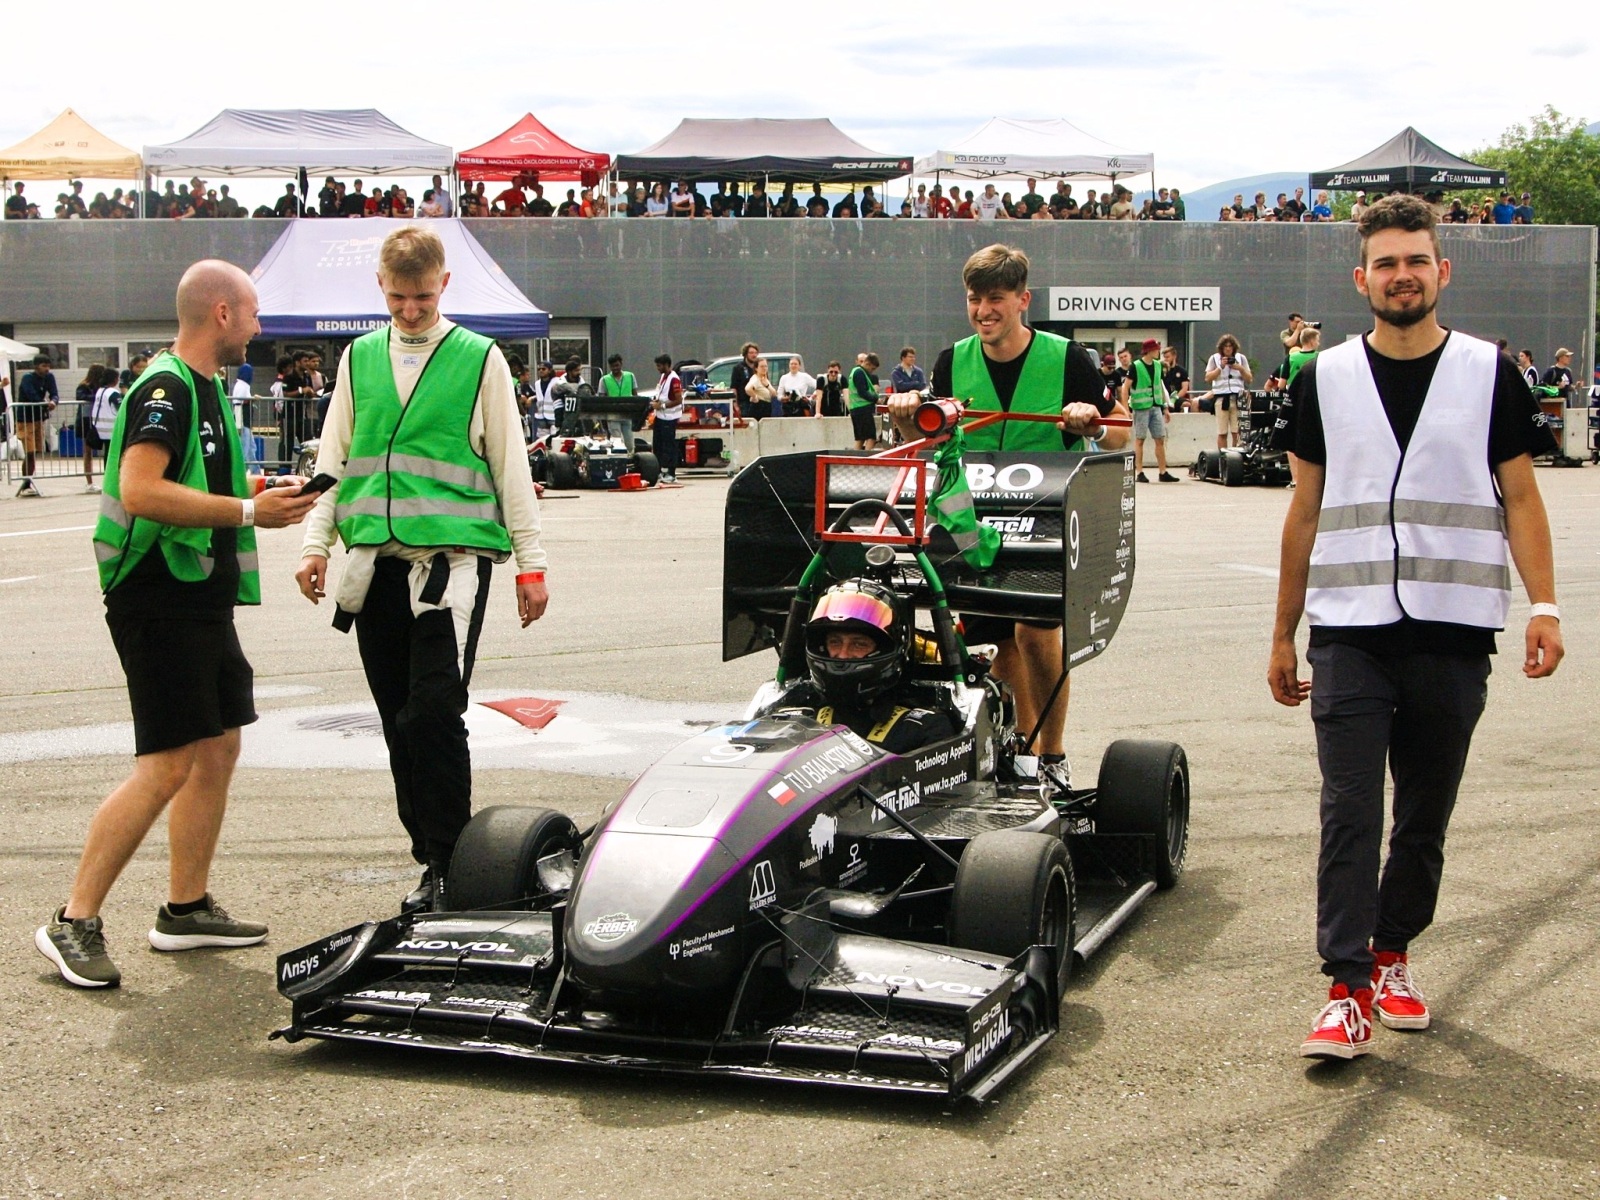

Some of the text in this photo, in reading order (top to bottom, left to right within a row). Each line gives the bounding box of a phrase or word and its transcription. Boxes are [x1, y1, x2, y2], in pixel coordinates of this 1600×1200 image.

[869, 161, 899, 169] STAR
[1343, 174, 1390, 185] TEAM TALLINN
[1446, 174, 1491, 185] TEAM TALLINN
[1058, 297, 1213, 312] DRIVING CENTER
[316, 320, 391, 331] REDBULLRIN
[565, 397, 577, 412] E77
[904, 462, 1044, 491] GBO
[1070, 510, 1080, 570] 9
[702, 743, 756, 763] 9
[915, 751, 949, 772] Technology
[950, 739, 972, 760] Applied
[784, 769, 813, 793] TU
[924, 770, 968, 795] www.ta.parts
[583, 920, 638, 935] CERBER
[682, 925, 735, 948] Faculty of Mechanical
[396, 941, 516, 953] NOVOL
[682, 943, 713, 958] Engineering
[282, 955, 319, 981] Ansys
[855, 971, 989, 997] NOVOL
[313, 1025, 424, 1041] INTRATEL
[814, 1072, 941, 1088] INTRATEL
